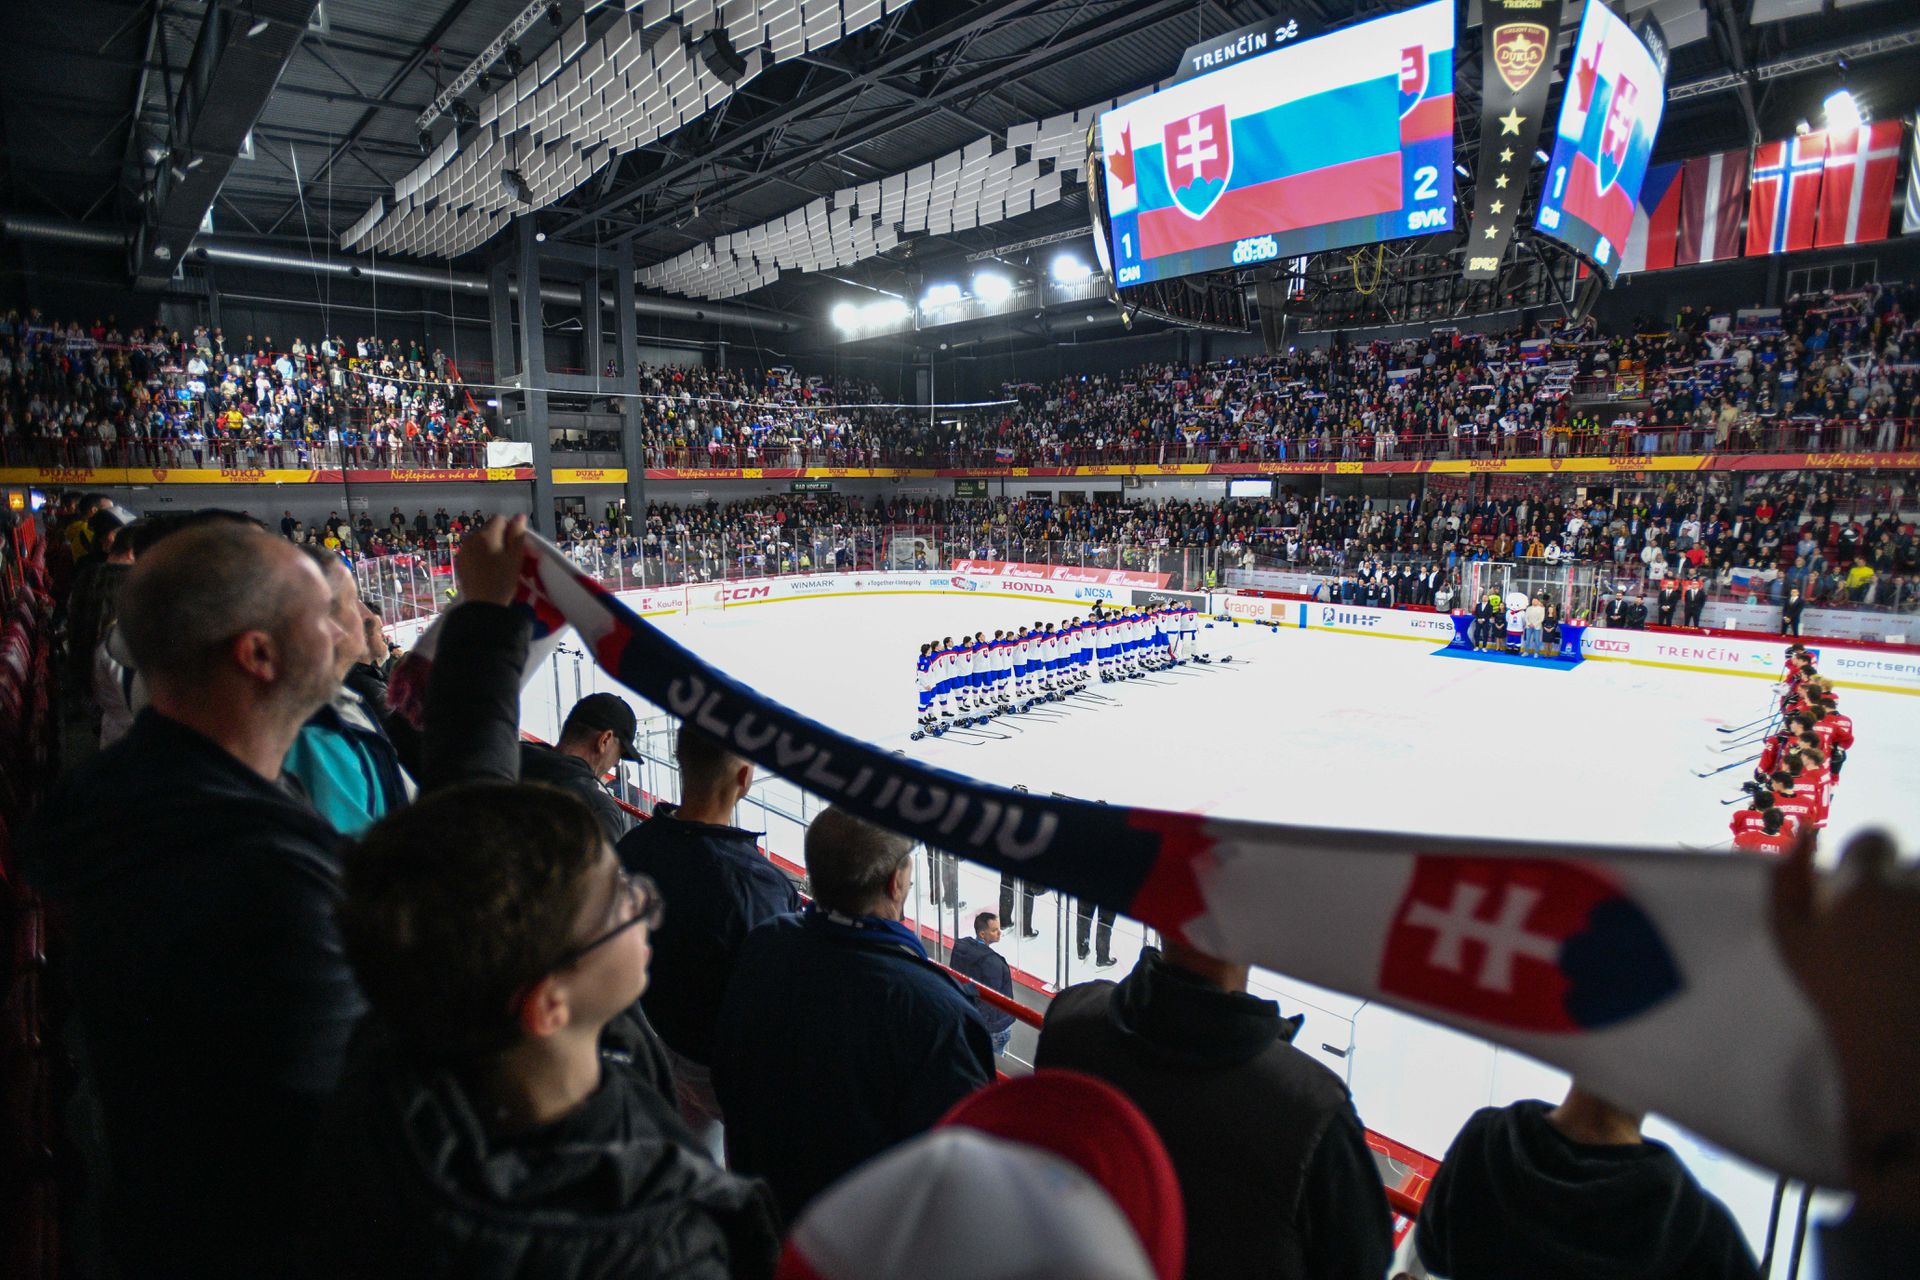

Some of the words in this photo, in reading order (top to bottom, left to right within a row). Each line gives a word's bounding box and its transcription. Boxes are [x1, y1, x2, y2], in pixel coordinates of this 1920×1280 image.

[1193, 33, 1267, 71] TRENČÍN
[1501, 50, 1538, 62] DUKLA
[1414, 166, 1438, 200] 2
[1553, 166, 1566, 199] 1
[1408, 207, 1447, 230] SVK
[1121, 233, 1132, 259] 1
[1118, 265, 1141, 282] CAN
[1470, 459, 1507, 467] DUKLA
[1609, 457, 1653, 465] DUKLA
[1805, 453, 1875, 468] Najlepšia
[220, 469, 266, 477] DUKLA
[1335, 462, 1364, 474] 1962
[791, 580, 835, 589] WINMARK
[1002, 581, 1054, 593] HONDA
[1084, 588, 1113, 598] NCSA
[1339, 612, 1382, 626] IIHF
[1595, 640, 1629, 652] LIVE
[1657, 645, 1740, 662] TRENČÍN
